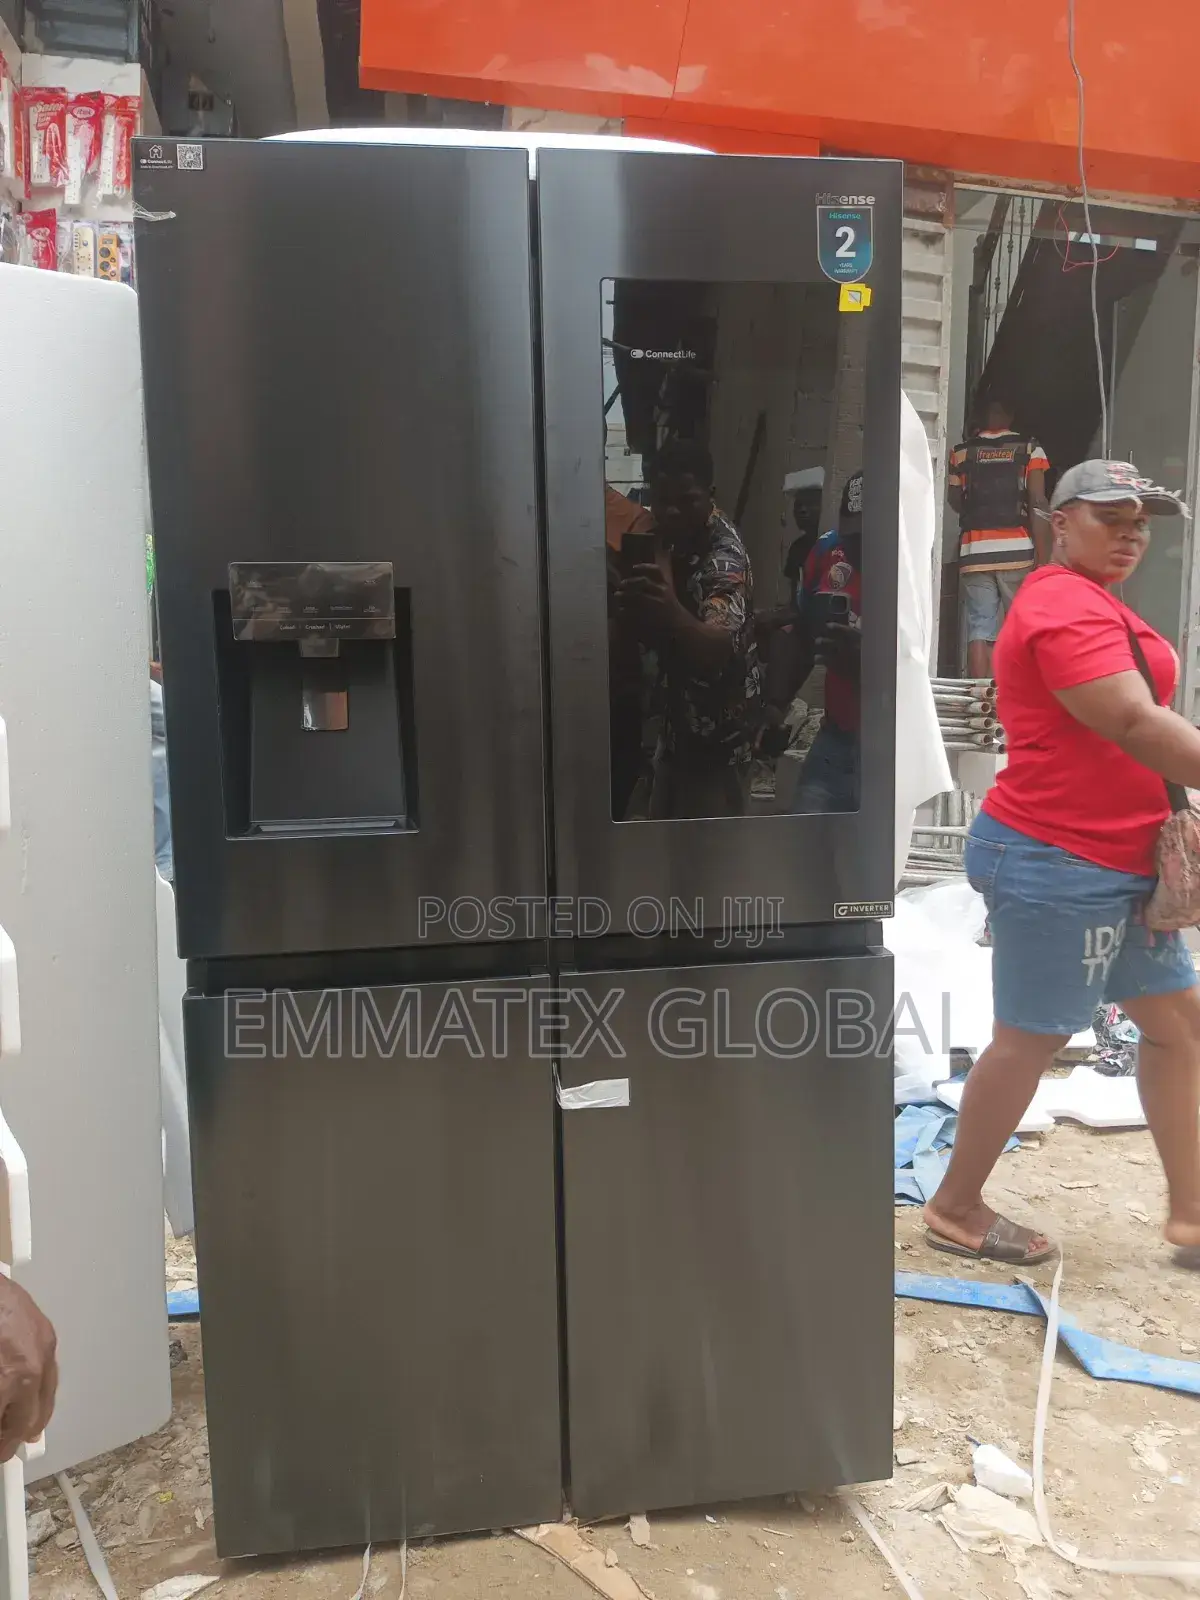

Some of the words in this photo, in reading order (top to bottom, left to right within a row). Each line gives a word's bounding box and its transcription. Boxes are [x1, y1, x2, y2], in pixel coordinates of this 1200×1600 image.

[815, 193, 876, 205] Hisense
[835, 226, 856, 258] 2
[645, 349, 697, 359] ConnectLife
[850, 904, 889, 912] INVERTER
